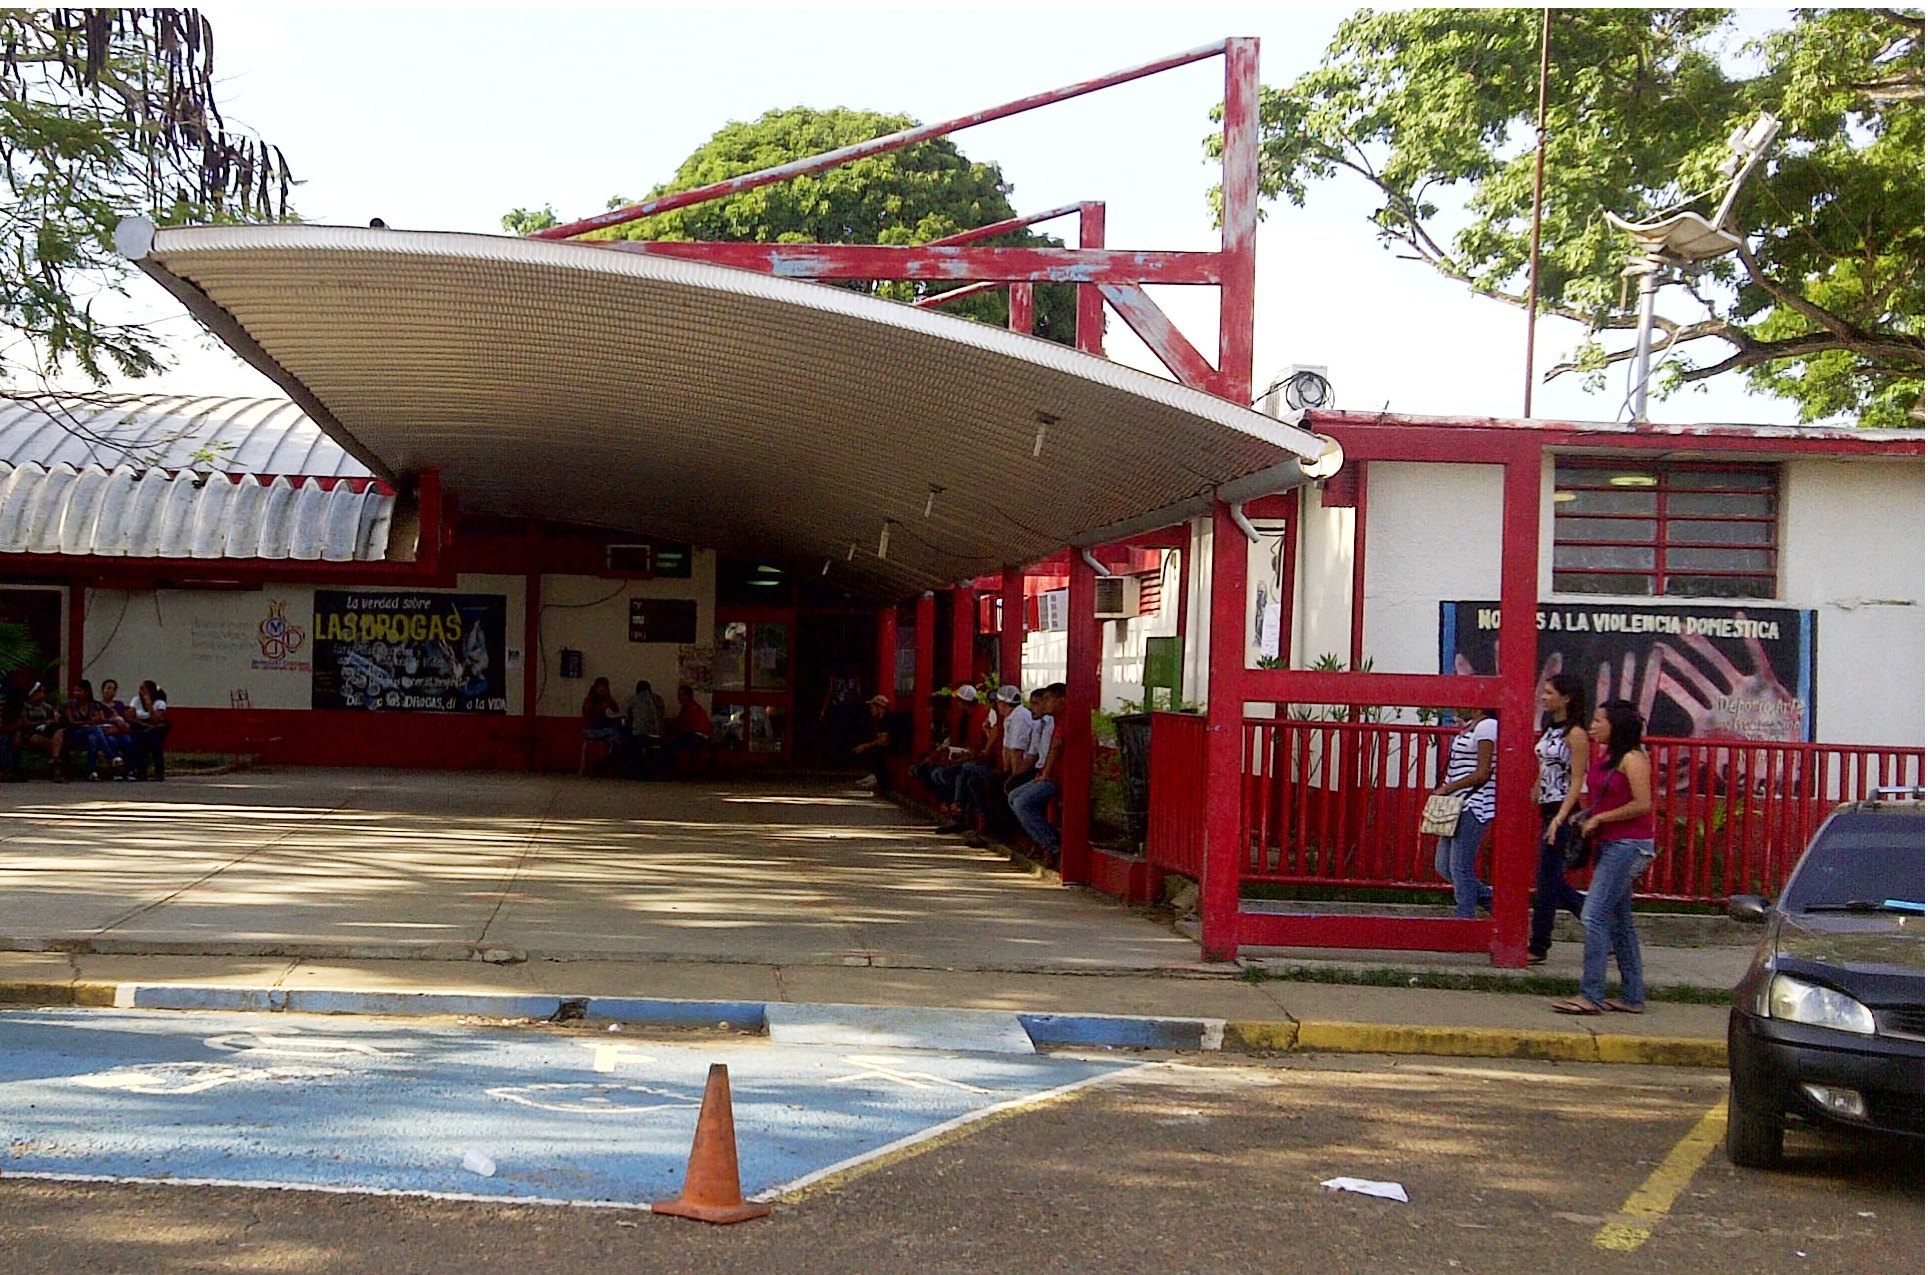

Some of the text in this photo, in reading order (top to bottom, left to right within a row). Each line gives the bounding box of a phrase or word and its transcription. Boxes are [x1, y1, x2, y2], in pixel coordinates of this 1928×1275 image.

[346, 597, 431, 609] La verdad sobre
[315, 612, 462, 642] LAS DROGAS
[1549, 612, 1562, 630] A
[1565, 613, 1590, 631] LA
[1592, 614, 1681, 633] VIOLENCIA
[1686, 616, 1780, 640] DOMESTICA
[404, 695, 445, 711] DROGAS,
